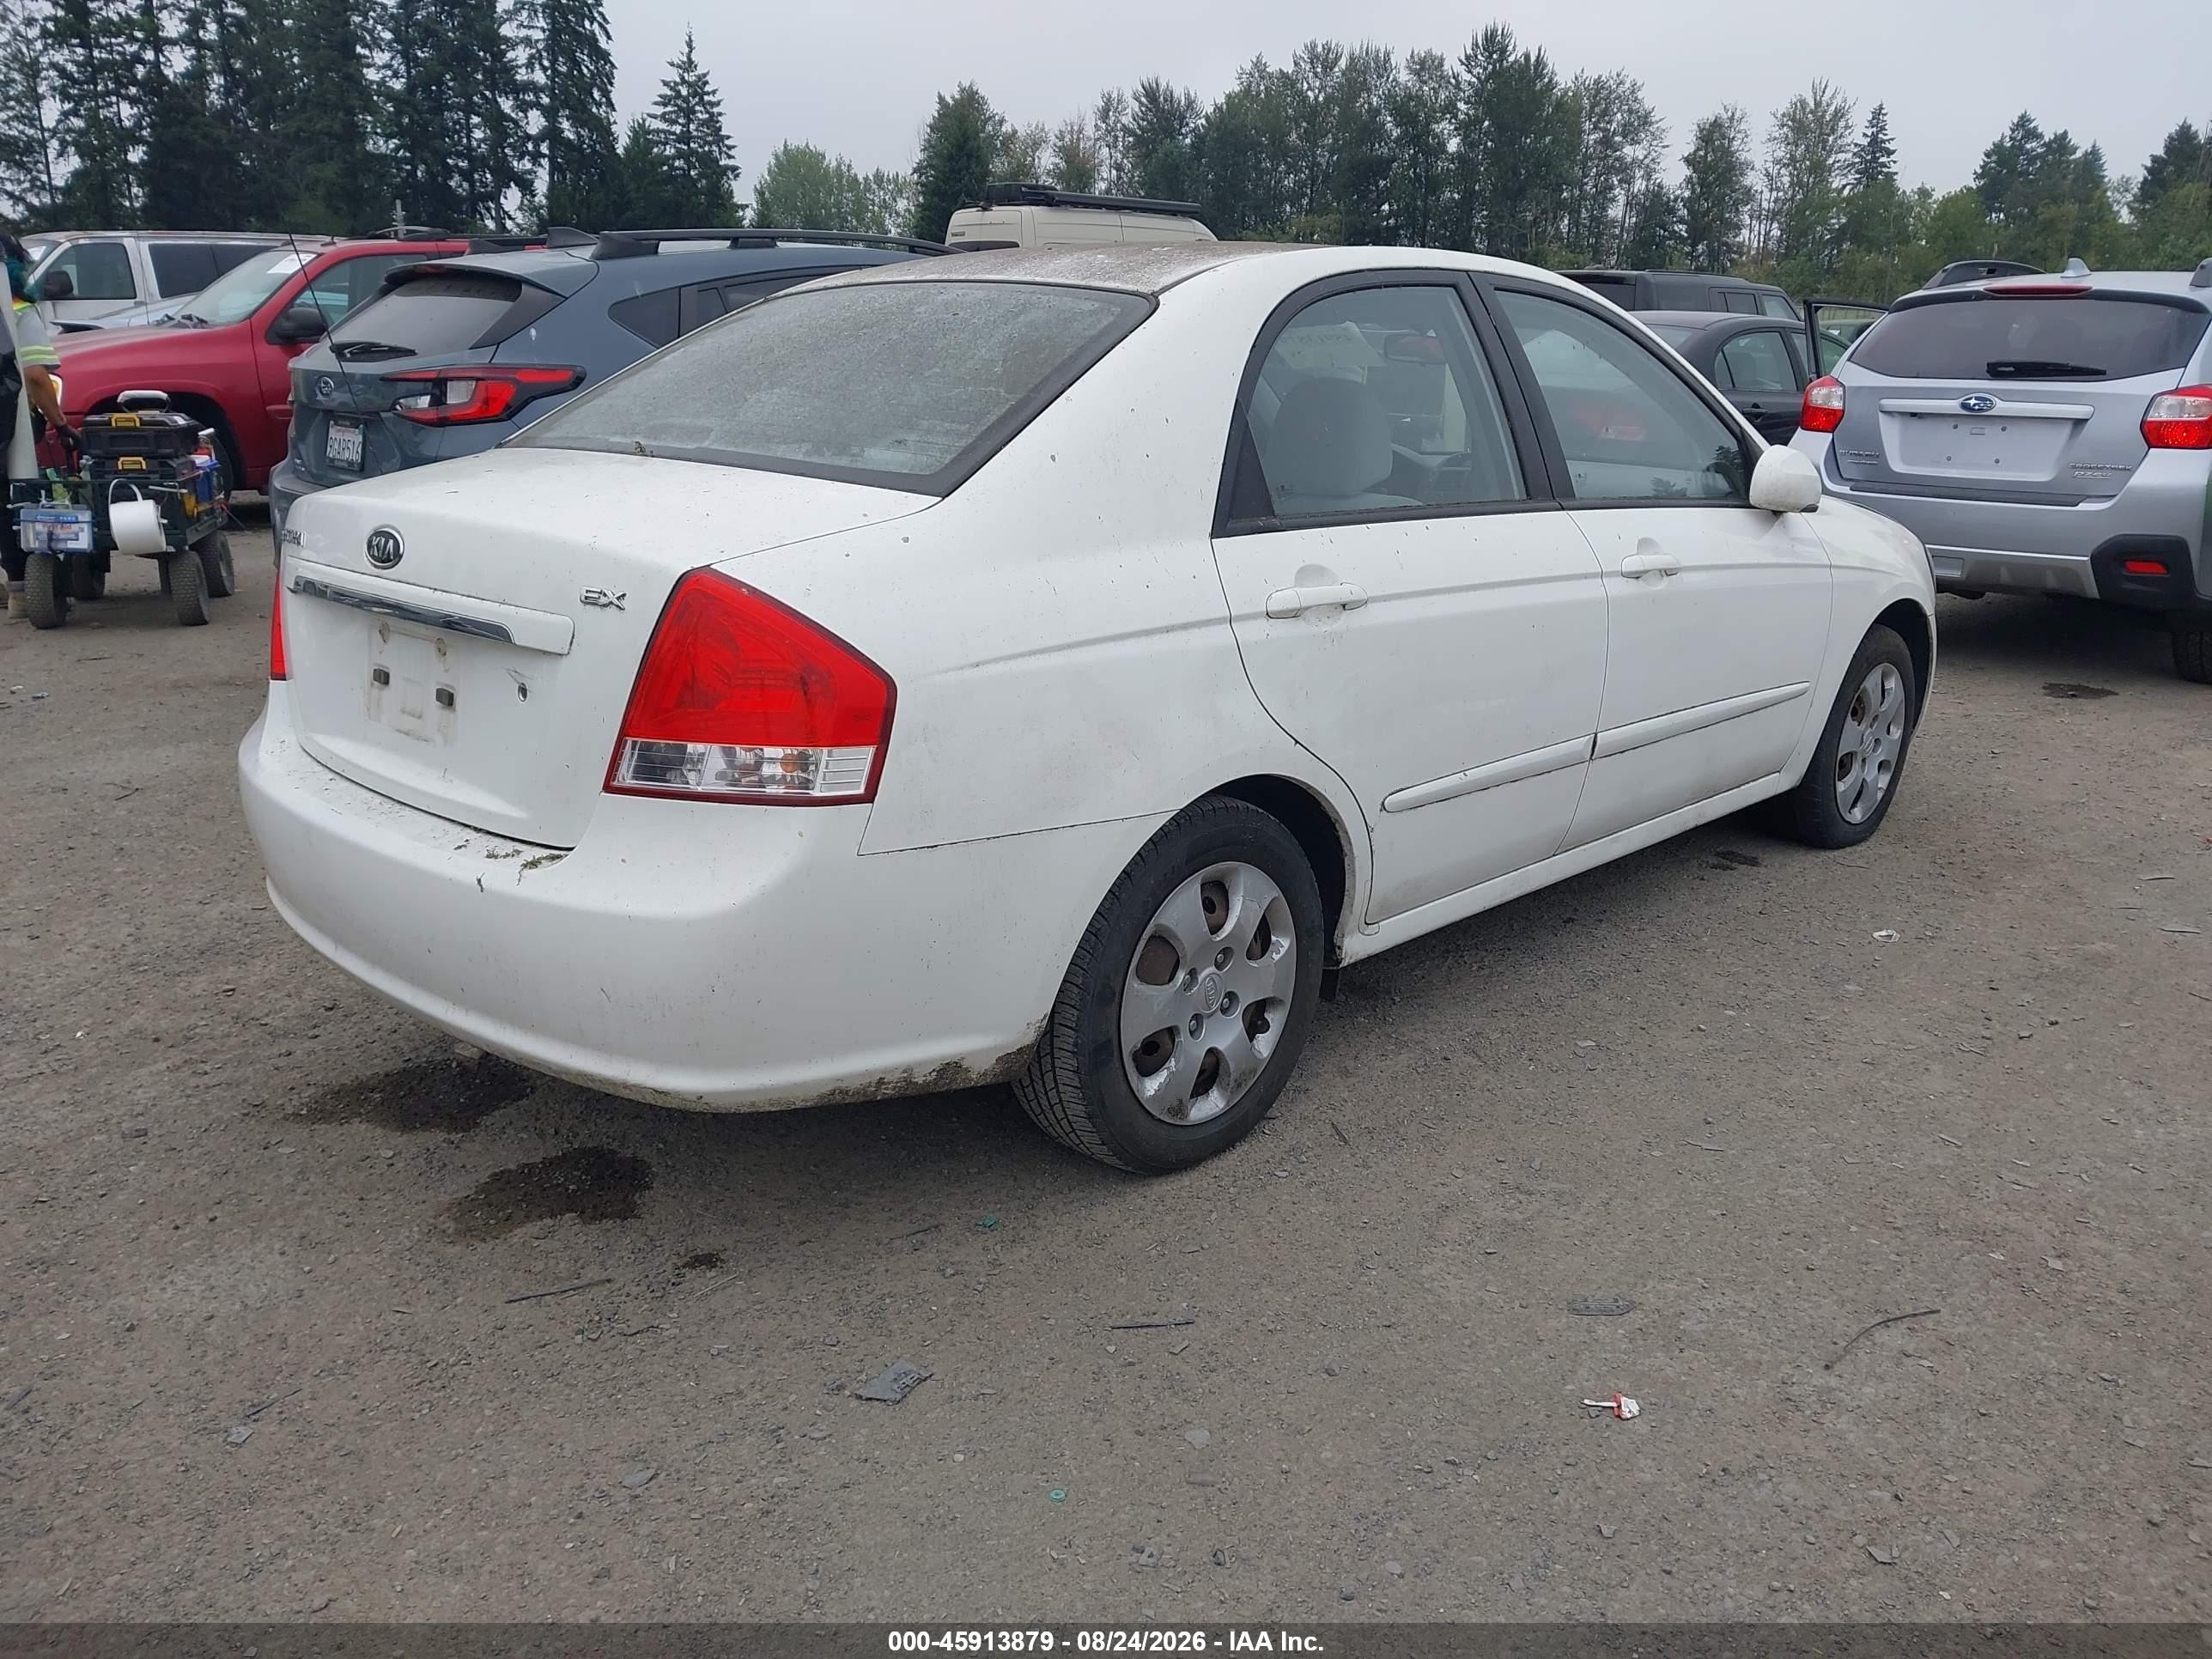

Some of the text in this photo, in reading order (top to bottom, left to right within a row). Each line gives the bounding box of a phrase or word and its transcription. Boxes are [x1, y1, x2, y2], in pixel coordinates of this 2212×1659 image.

[328, 436, 362, 462] 9GAR516
[369, 535, 394, 560] KIA
[580, 586, 627, 611] EX
